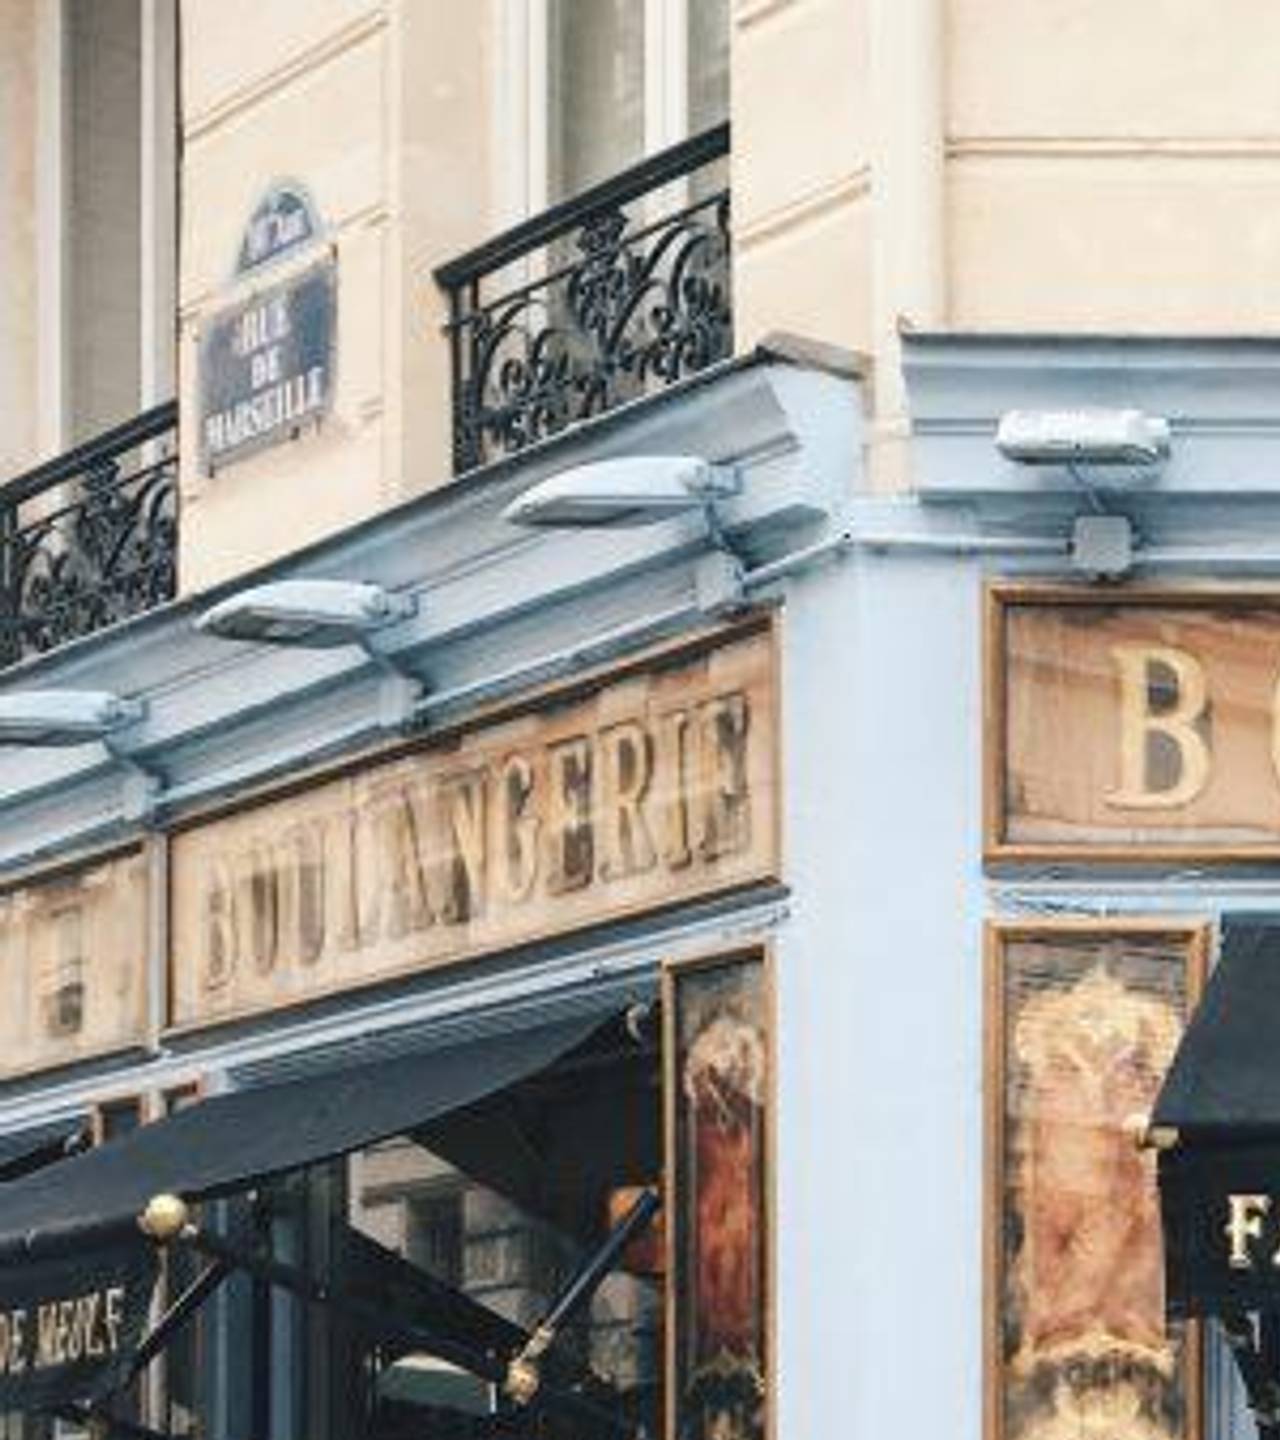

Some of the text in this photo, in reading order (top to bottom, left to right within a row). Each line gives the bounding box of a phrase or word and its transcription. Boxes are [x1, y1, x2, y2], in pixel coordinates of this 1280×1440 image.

[233, 300, 291, 355] RUE
[251, 345, 283, 392] DE
[198, 690, 752, 992] BOULANGERIE
